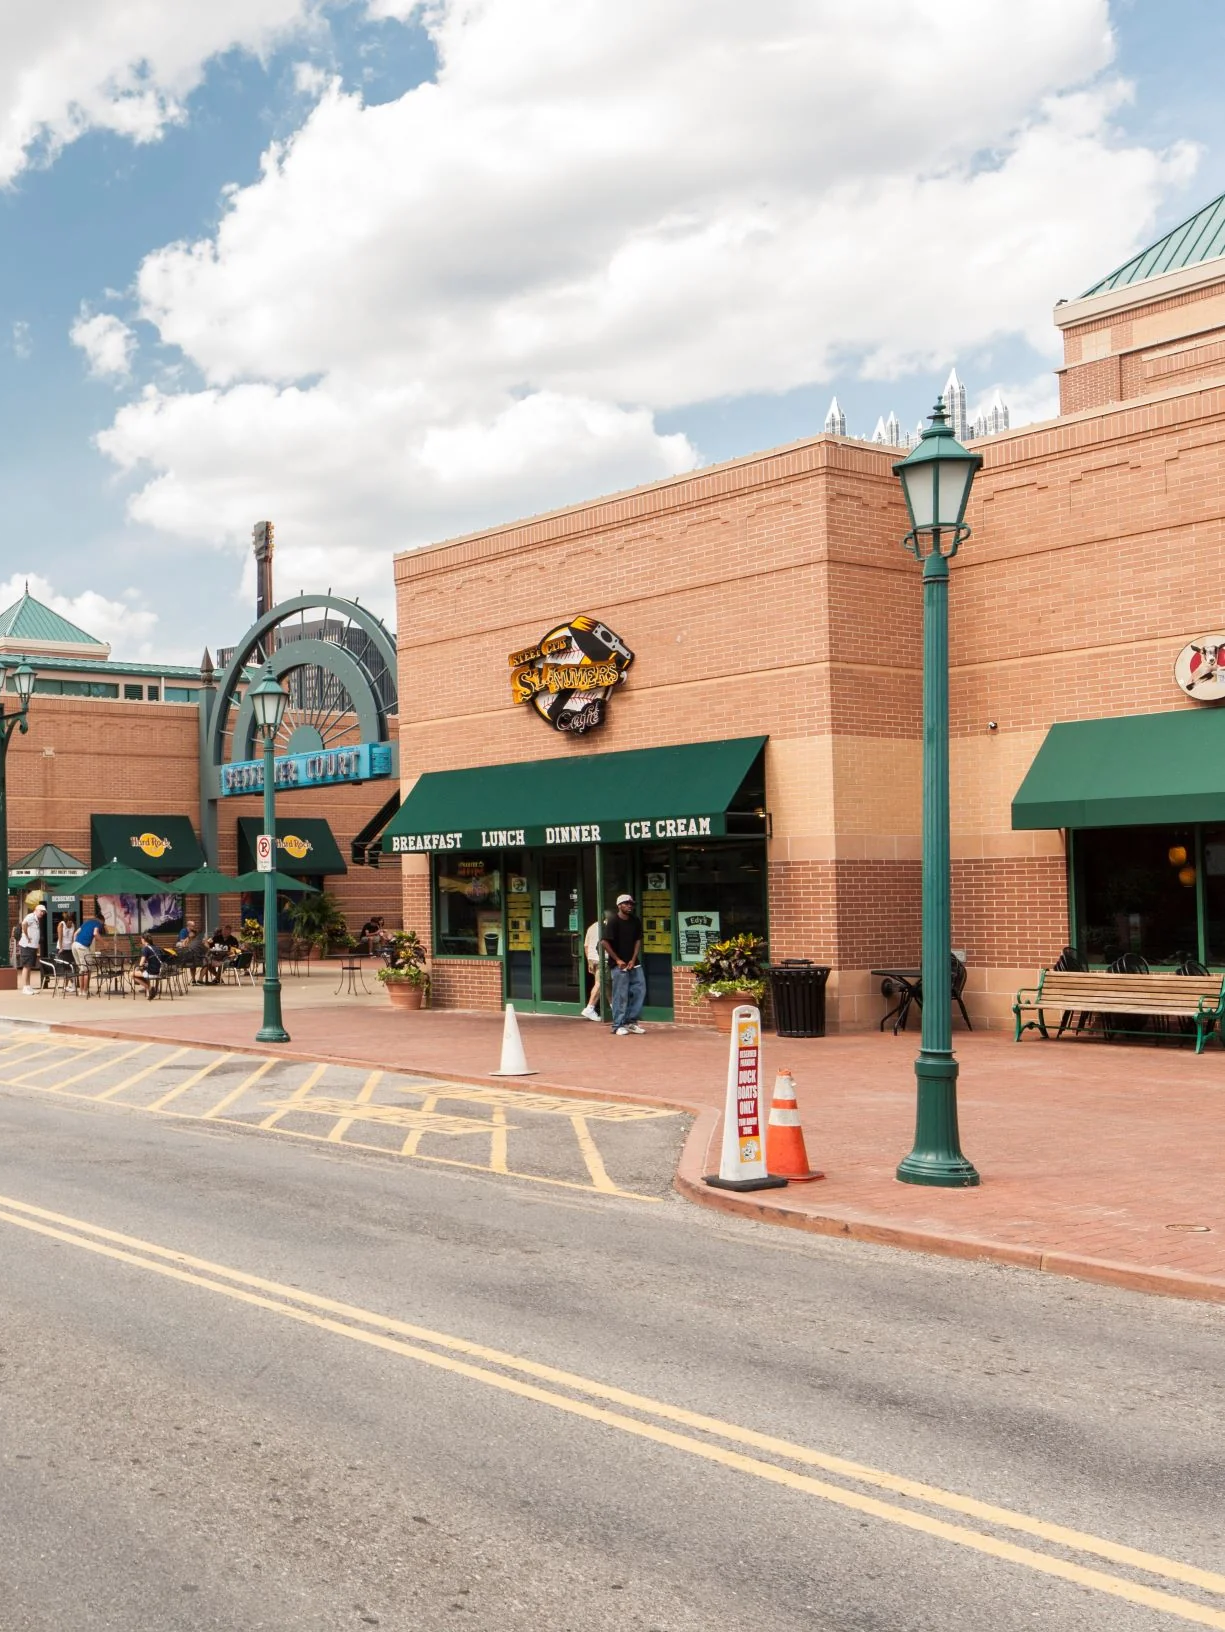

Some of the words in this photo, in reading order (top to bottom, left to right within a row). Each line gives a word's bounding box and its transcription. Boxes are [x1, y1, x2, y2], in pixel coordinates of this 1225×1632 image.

[518, 663, 619, 702] SLAMMERS
[307, 751, 360, 779] COURT
[392, 833, 463, 852] BREAKFAST
[481, 830, 525, 847] LUNCH
[545, 825, 602, 844] DINNER
[625, 821, 652, 840] ICE
[655, 817, 712, 837] CREAM
[130, 836, 150, 847] Hard
[151, 837, 173, 850] Rock
[275, 838, 293, 849] Hard
[294, 839, 314, 851] Rock
[738, 1070, 757, 1085] DUCK
[737, 1085, 758, 1099] BOATS
[739, 1100, 755, 1115] ONLY
